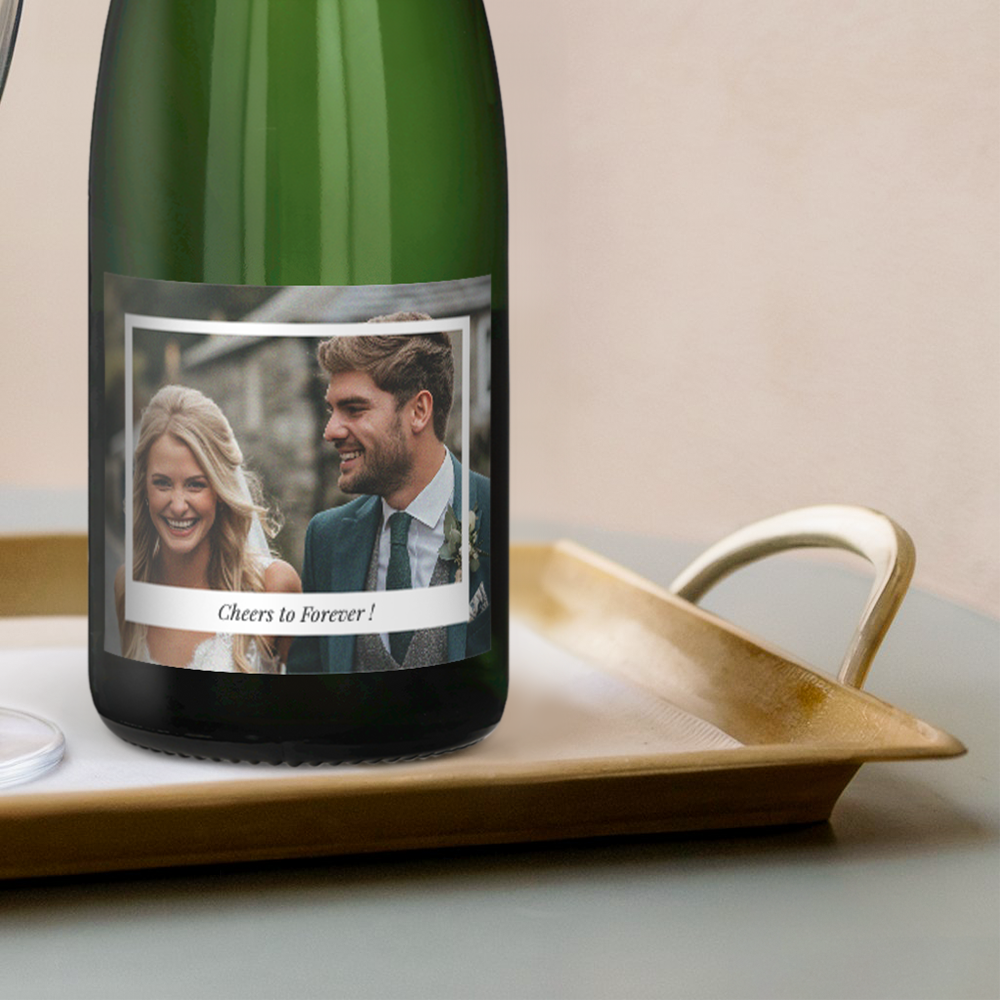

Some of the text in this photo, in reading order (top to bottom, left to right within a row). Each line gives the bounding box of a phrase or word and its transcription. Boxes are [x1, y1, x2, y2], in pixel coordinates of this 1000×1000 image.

[218, 603, 274, 622] Cheers
[279, 607, 295, 623] to
[299, 606, 365, 623] Forever
